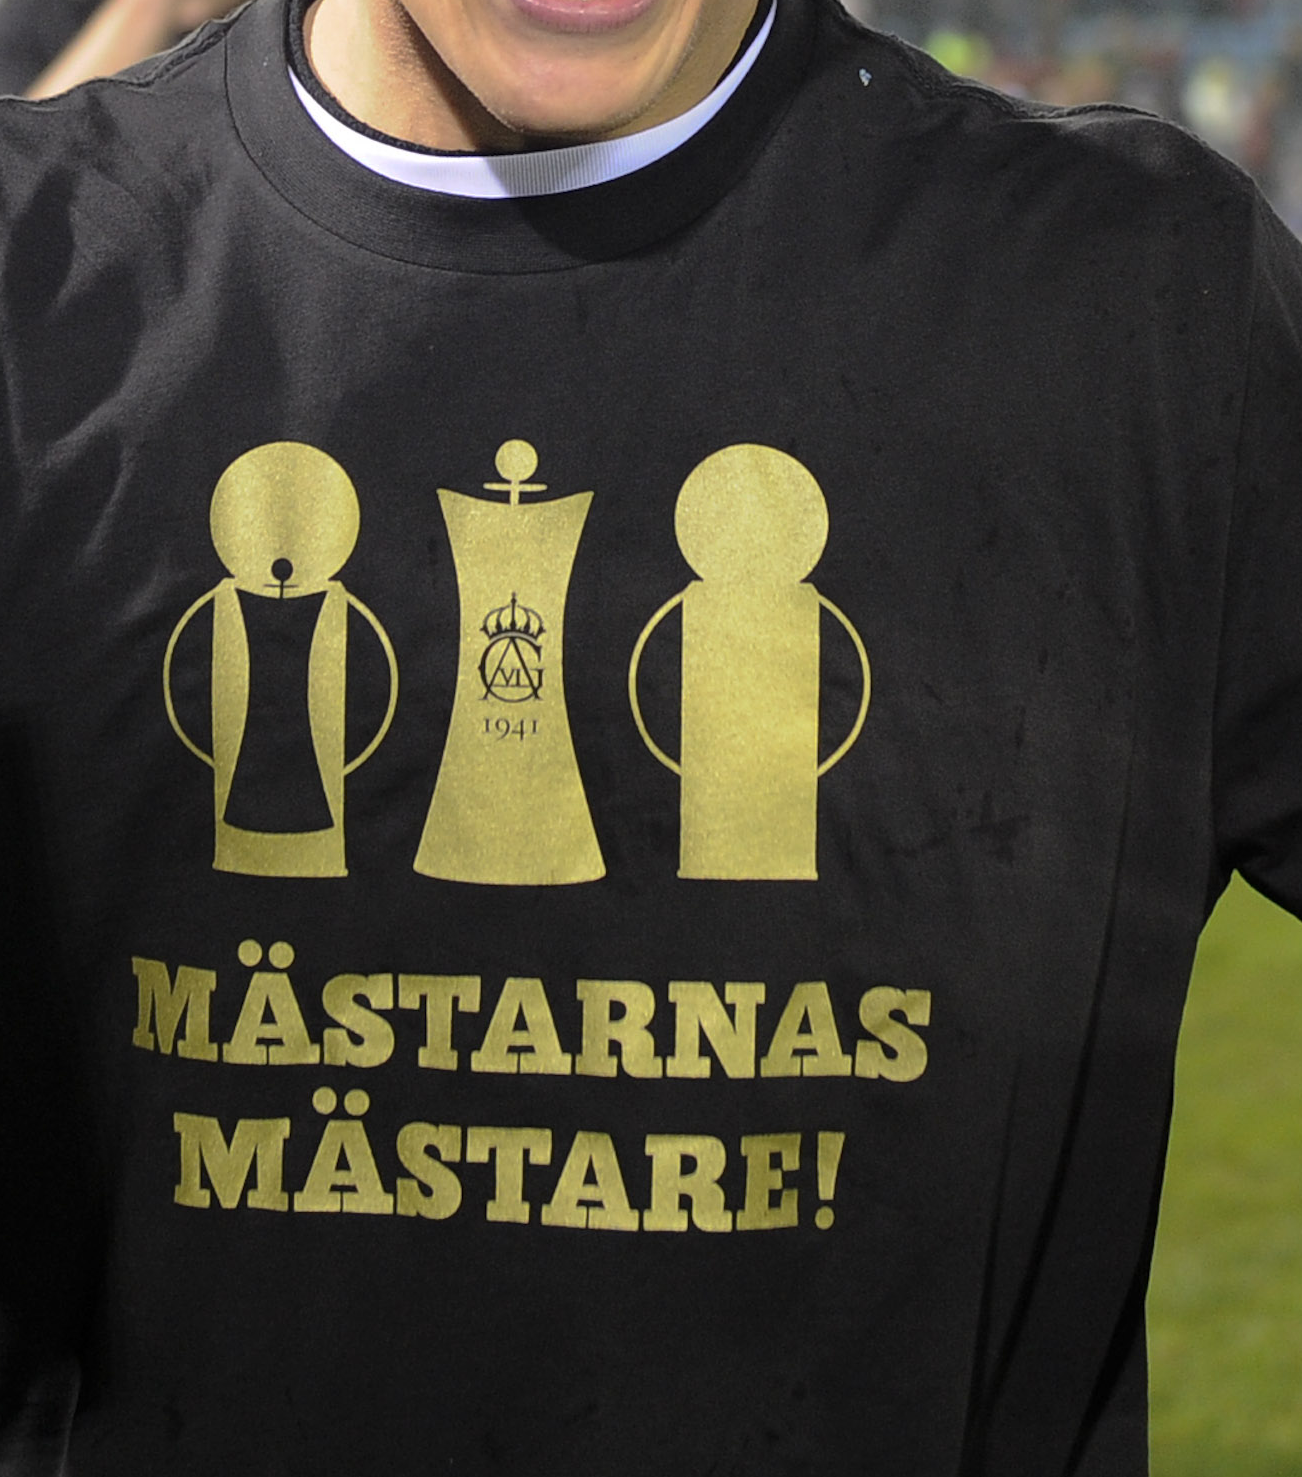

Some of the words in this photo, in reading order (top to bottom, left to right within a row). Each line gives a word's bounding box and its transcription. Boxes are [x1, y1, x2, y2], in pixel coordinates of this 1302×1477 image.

[482, 717, 540, 742] 1941
[132, 939, 932, 1083] MÄSTARNAS
[173, 1086, 846, 1233] MÄSTARE!
